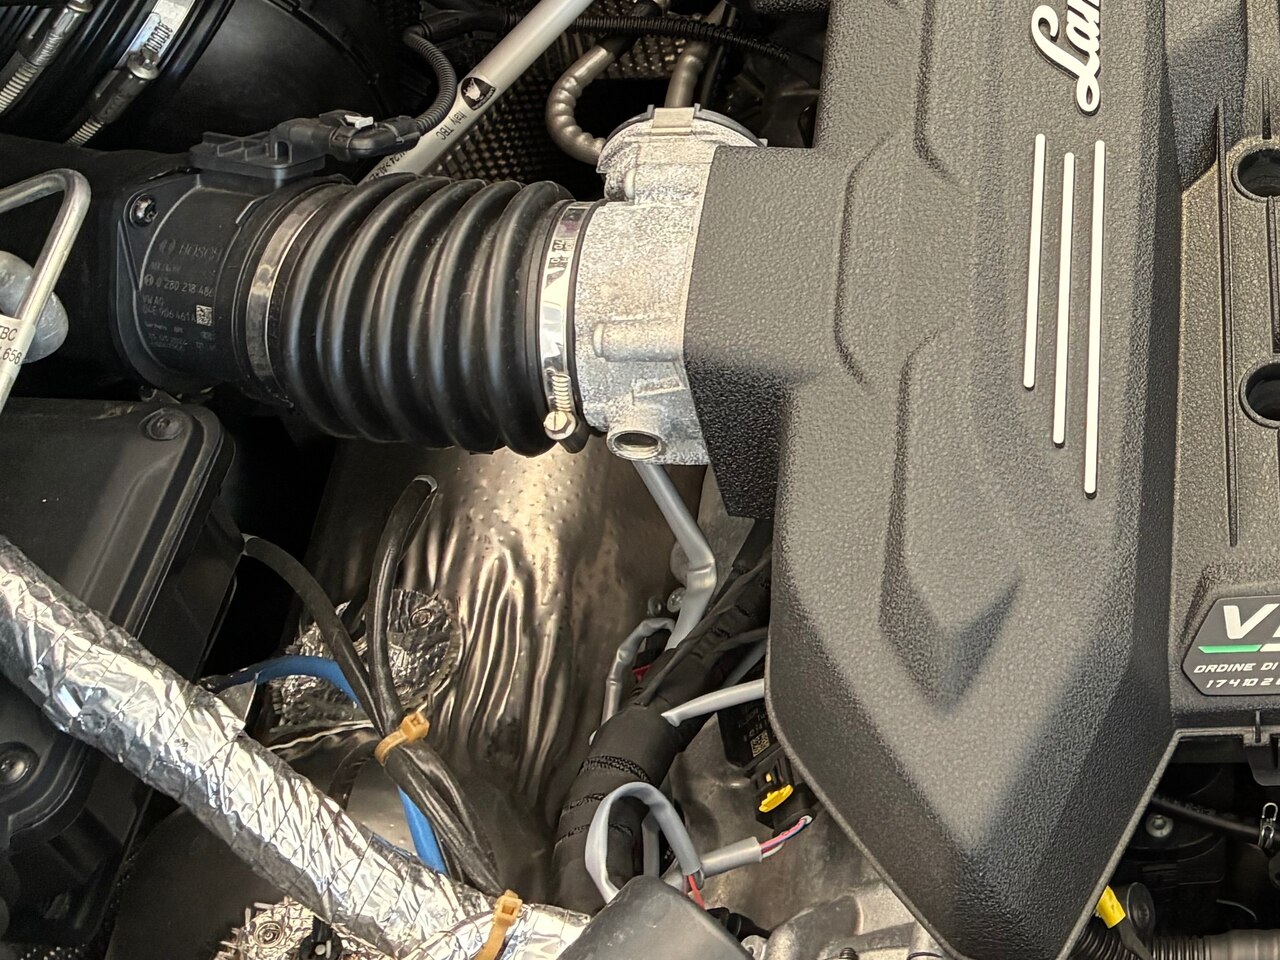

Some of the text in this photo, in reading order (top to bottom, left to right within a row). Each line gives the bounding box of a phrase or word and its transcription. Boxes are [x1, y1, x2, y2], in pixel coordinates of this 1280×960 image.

[435, 109, 468, 141] Italy TBC
[0, 325, 18, 342] BC
[1193, 662, 1257, 674] ORDINE
[1260, 661, 1279, 671] DI
